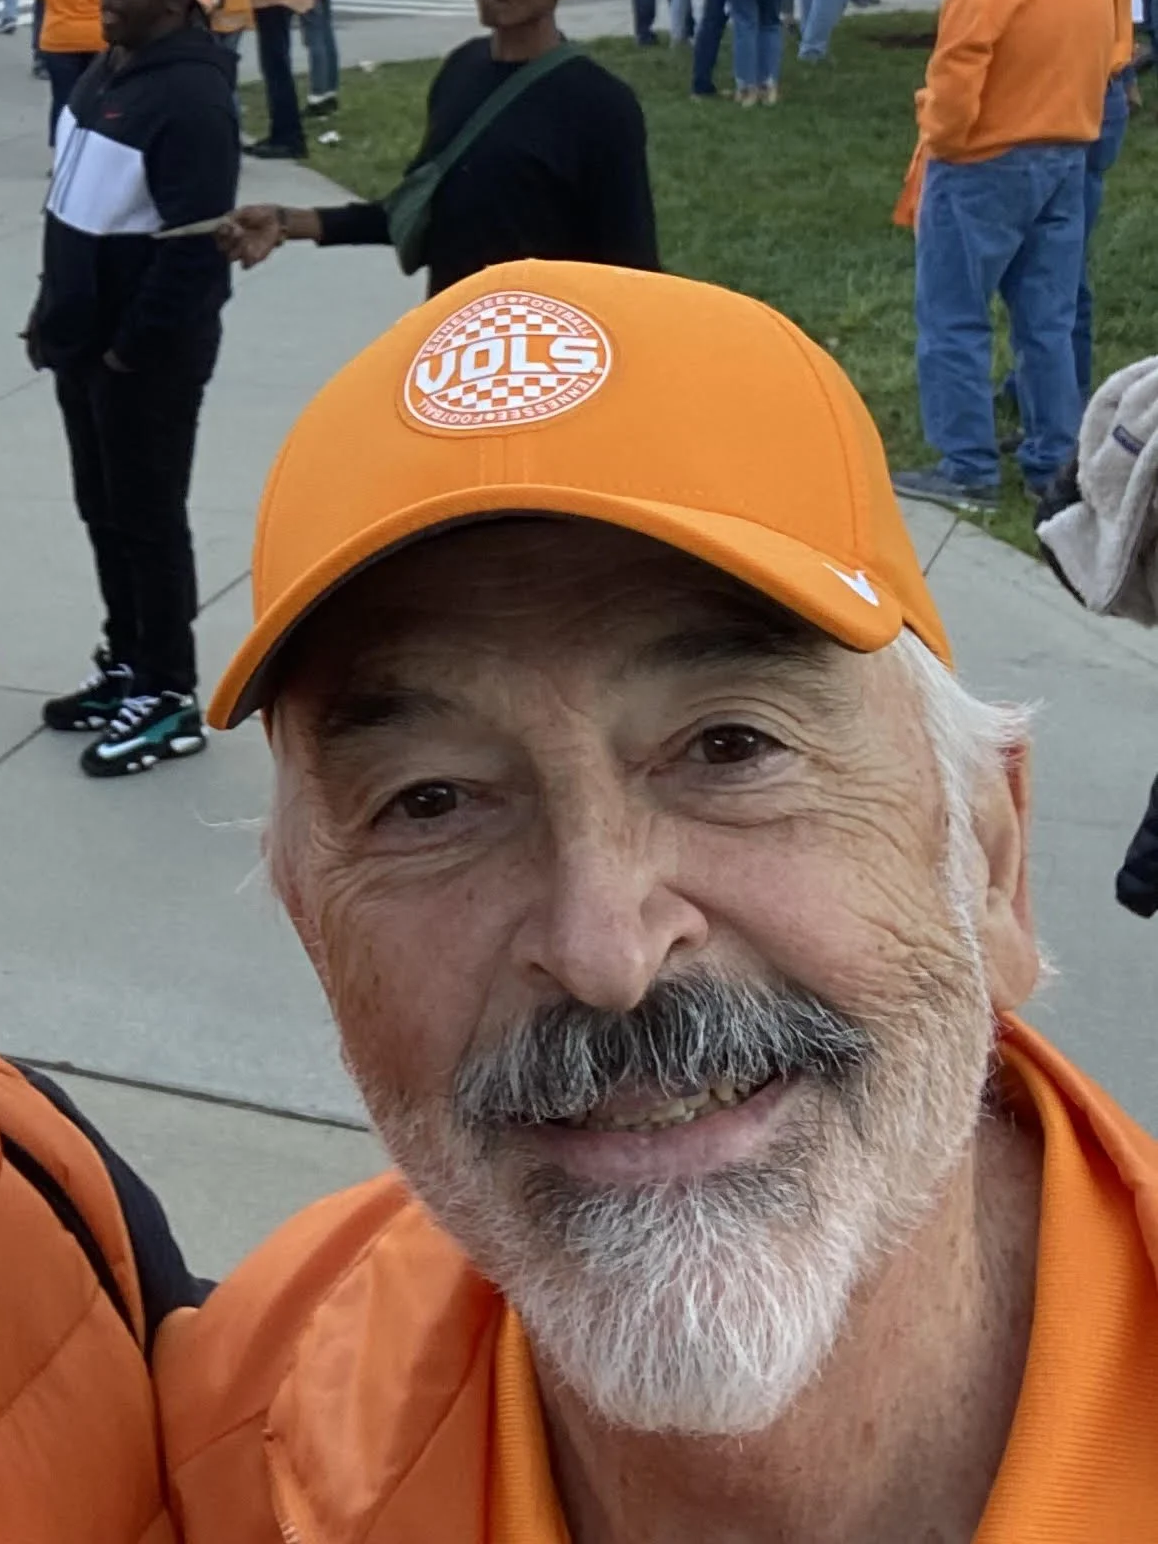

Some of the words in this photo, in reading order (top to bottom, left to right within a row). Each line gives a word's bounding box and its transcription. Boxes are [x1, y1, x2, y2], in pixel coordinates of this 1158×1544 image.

[420, 295, 506, 359] TENNESSEE
[518, 296, 595, 337] FOOTBALL
[415, 336, 599, 395] VOLS
[417, 398, 487, 425] FOOTBALL
[497, 376, 596, 421] TENNESSEE
